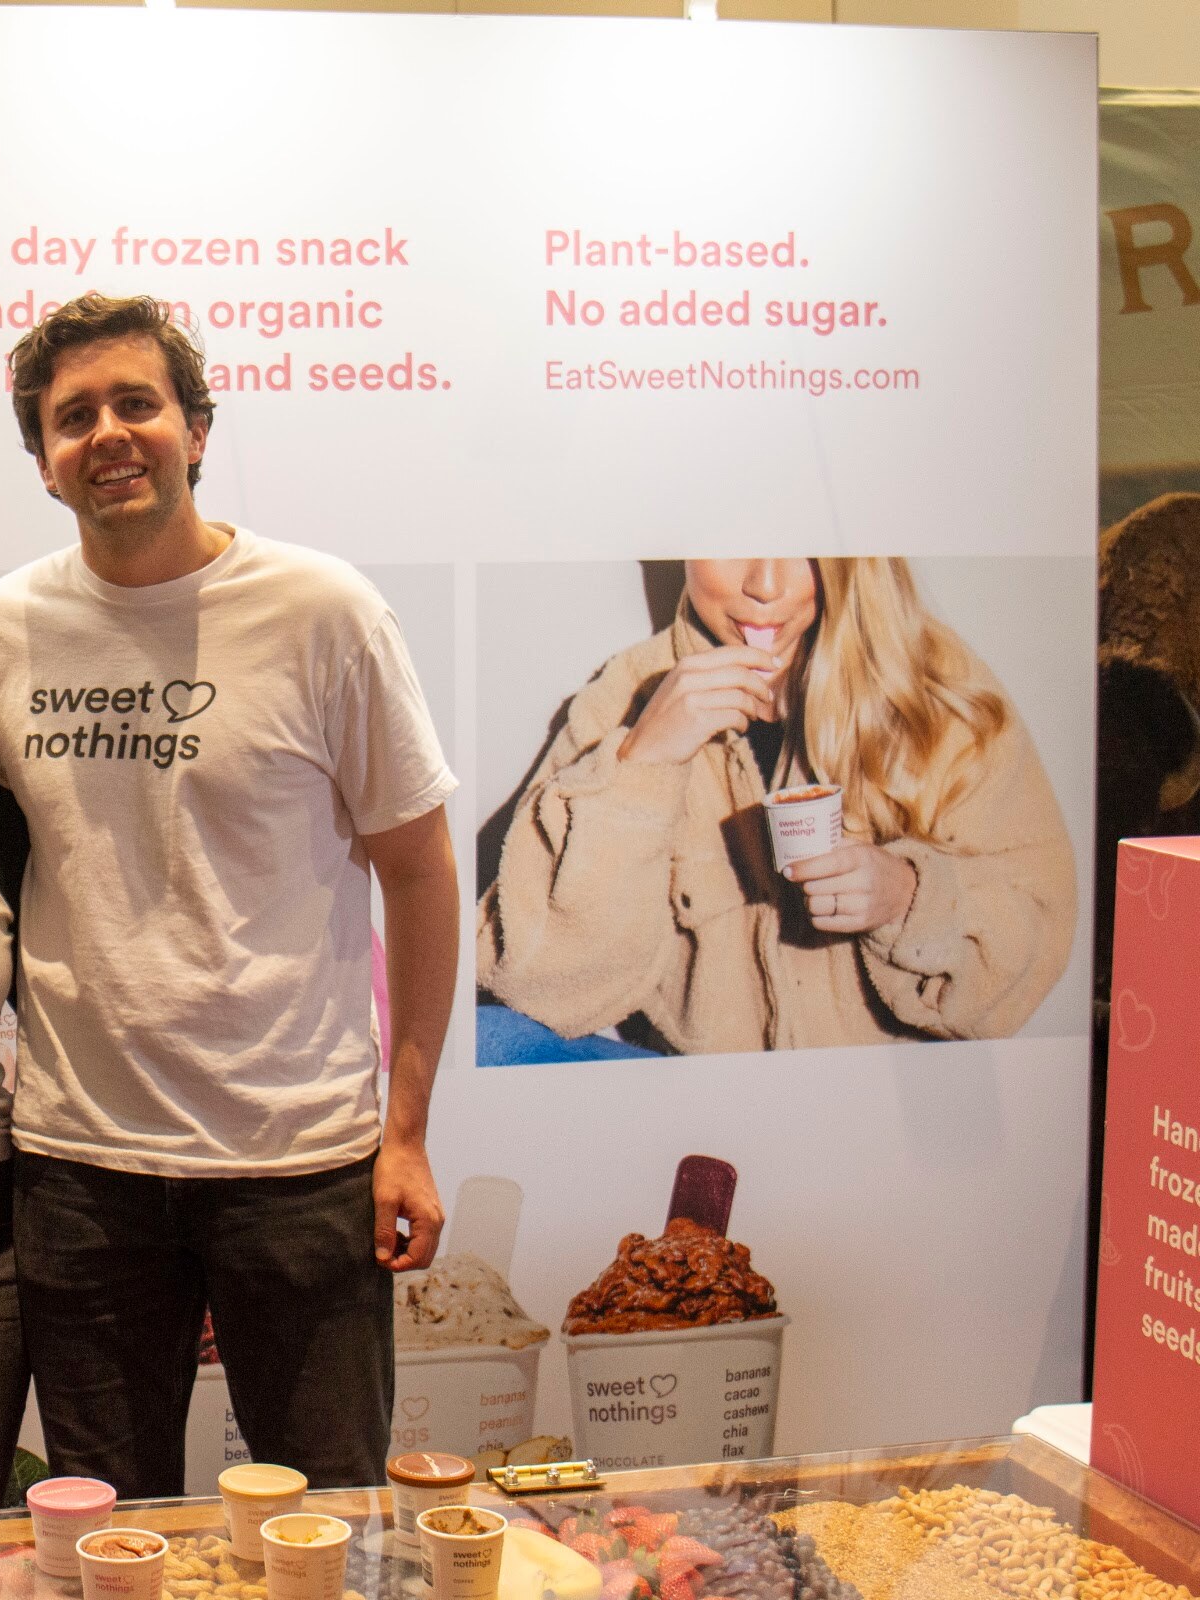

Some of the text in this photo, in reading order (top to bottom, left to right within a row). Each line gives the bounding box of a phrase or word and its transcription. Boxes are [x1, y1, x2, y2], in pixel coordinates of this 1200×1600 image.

[11, 227, 96, 275] day
[112, 227, 260, 266] frozen
[276, 227, 409, 266] snack
[545, 230, 809, 268] Plant-based.
[208, 290, 383, 338] organic
[546, 291, 887, 336] No added sugar.
[208, 353, 292, 392] and
[308, 353, 452, 392] seeds.
[546, 361, 919, 396] EatSweetNothings.com
[29, 681, 154, 714] sweet
[24, 722, 201, 769] nothings
[1153, 1105, 1200, 1155] Han
[1147, 1214, 1200, 1257] mad
[726, 1366, 771, 1383] bananas
[587, 1376, 645, 1397] sweet
[724, 1386, 760, 1402] cacao
[480, 1391, 527, 1407] bananas
[589, 1401, 677, 1425] nothings
[723, 1403, 769, 1421] cashews
[722, 1424, 748, 1440] chia
[225, 1447, 251, 1460] bee
[722, 1444, 745, 1459] flax
[453, 1551, 481, 1559] sweet
[453, 1559, 491, 1569] nothings
[95, 1574, 121, 1582] sweet
[95, 1583, 134, 1593] nothings
